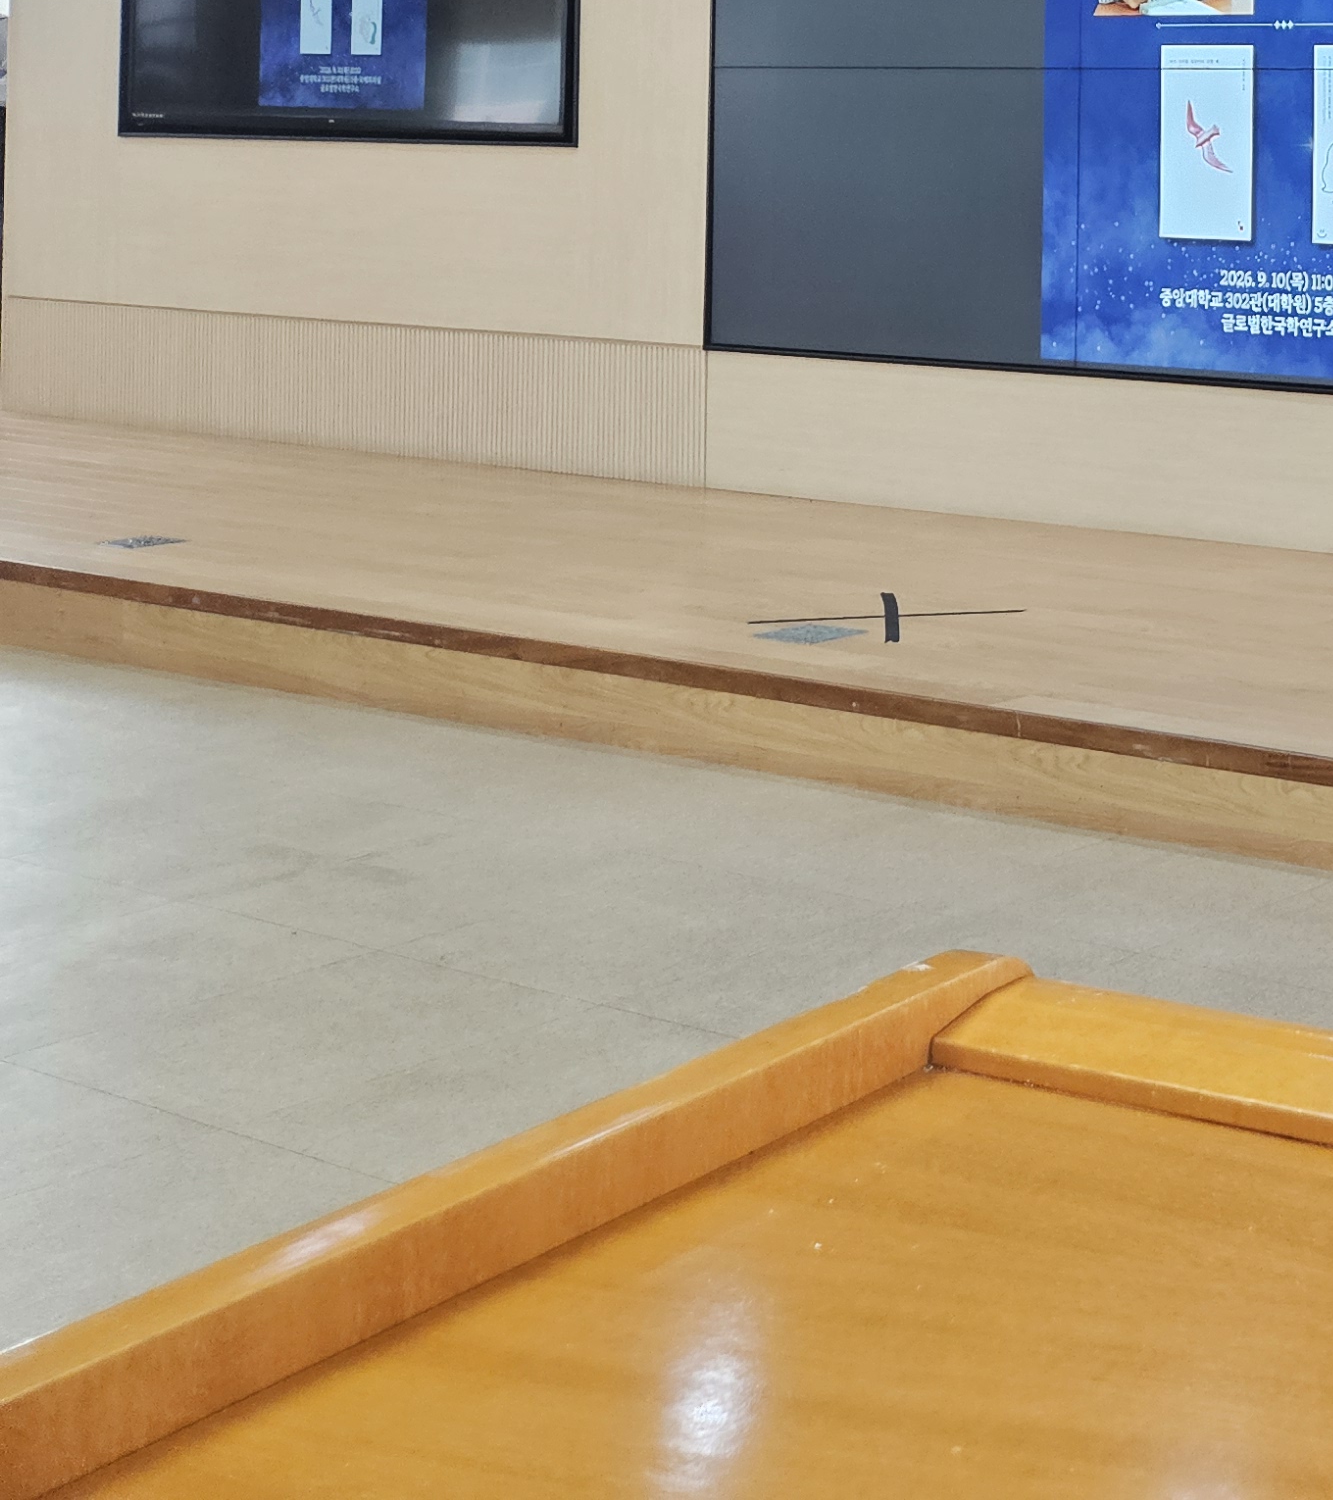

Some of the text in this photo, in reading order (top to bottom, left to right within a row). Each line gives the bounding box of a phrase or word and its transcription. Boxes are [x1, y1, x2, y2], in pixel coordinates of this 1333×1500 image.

[1220, 270, 1256, 288] 2026.
[1257, 271, 1270, 288] 9.
[1271, 271, 1309, 292] 10(목)
[1159, 288, 1224, 309] 중앙대학교
[1225, 292, 1312, 315] 302관(대학원)
